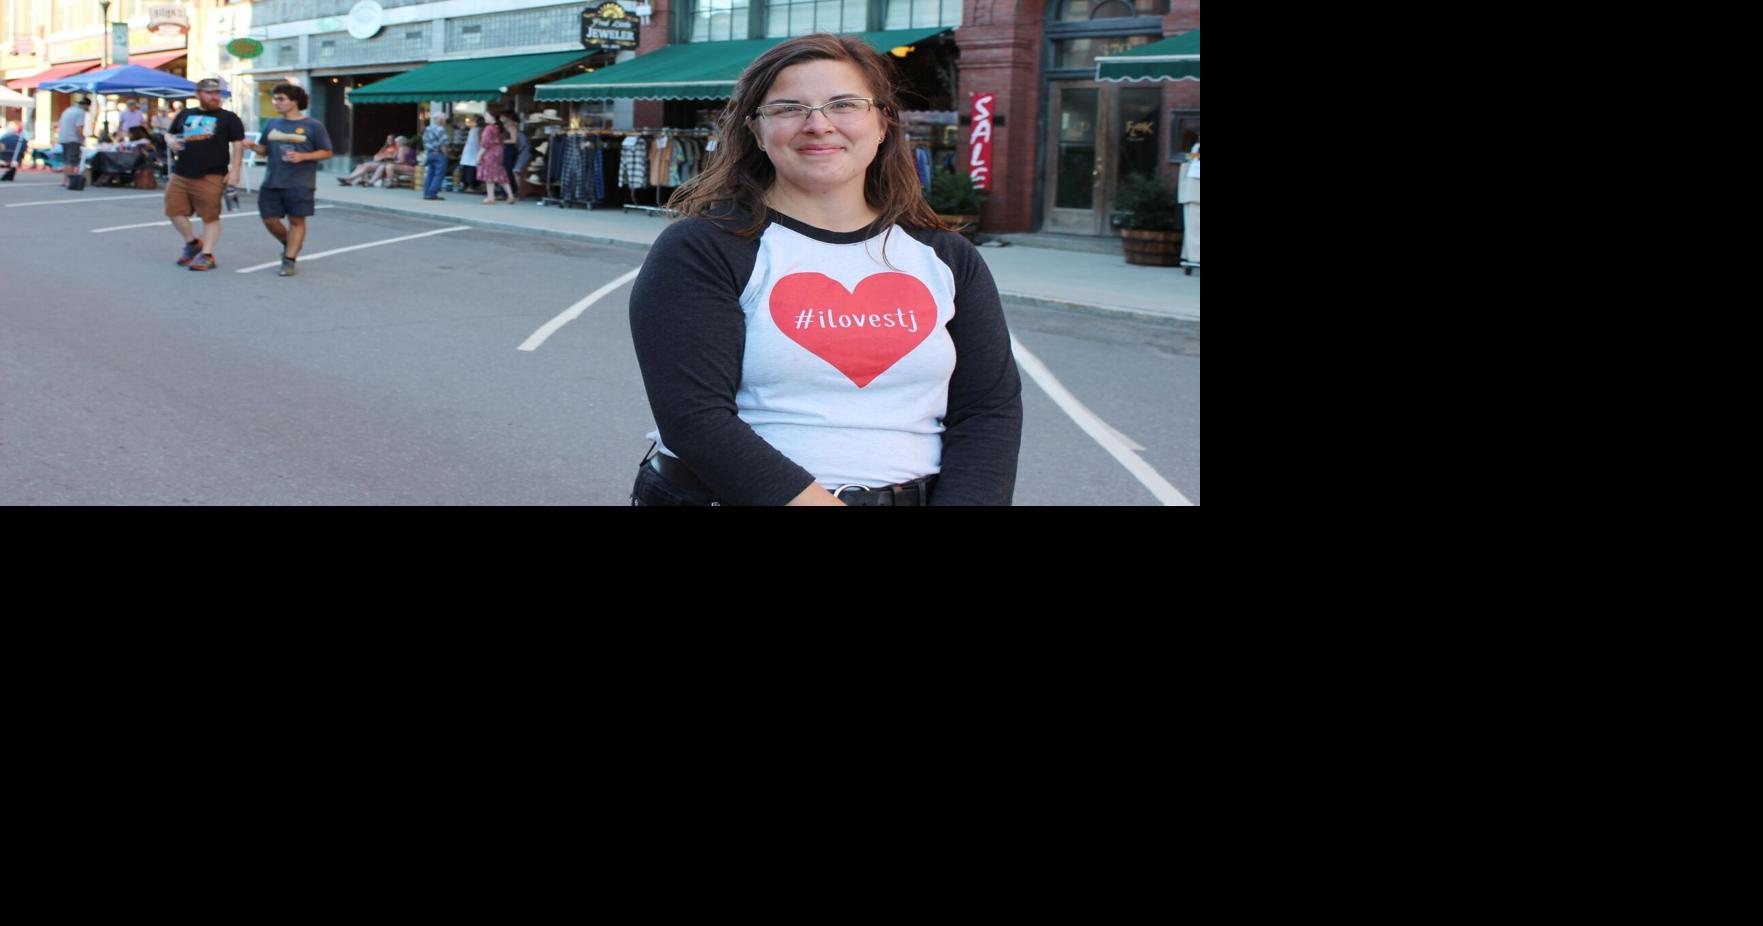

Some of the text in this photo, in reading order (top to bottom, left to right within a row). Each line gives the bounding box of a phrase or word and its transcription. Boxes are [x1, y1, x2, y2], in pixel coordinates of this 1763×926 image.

[586, 27, 635, 41] JEWELER
[969, 96, 992, 190] SALE
[794, 307, 919, 333] #ilovestj
